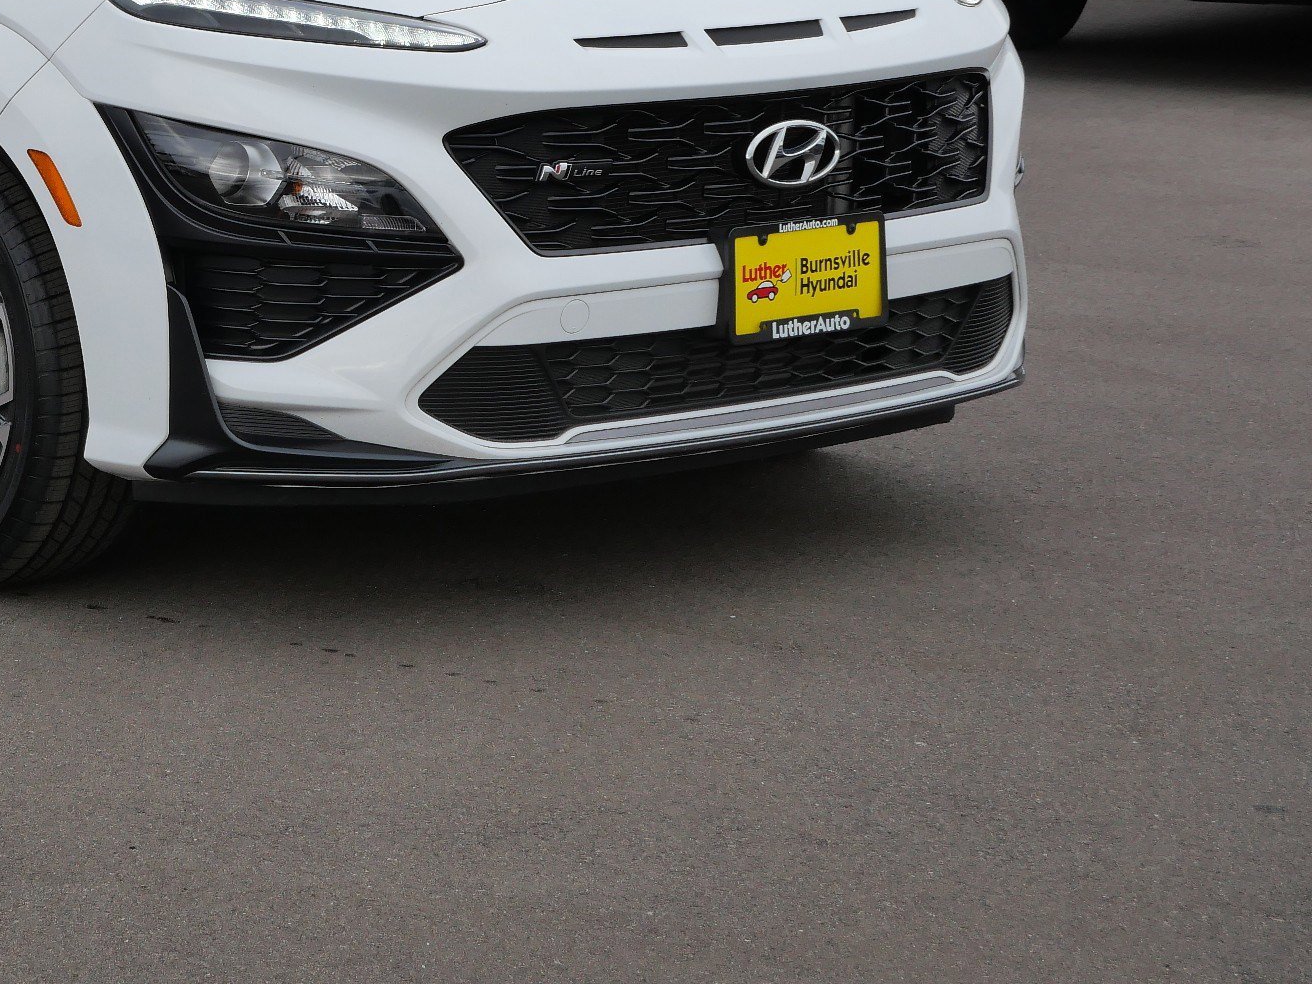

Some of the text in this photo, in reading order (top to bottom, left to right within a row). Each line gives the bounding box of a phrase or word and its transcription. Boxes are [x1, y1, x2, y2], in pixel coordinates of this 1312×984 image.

[573, 166, 603, 177] Line
[779, 218, 838, 233] LutherAuto.com
[742, 261, 788, 284] Luther
[800, 249, 870, 275] Burnsville
[800, 270, 858, 298] Hyundai
[772, 314, 850, 339] LutherAuto
